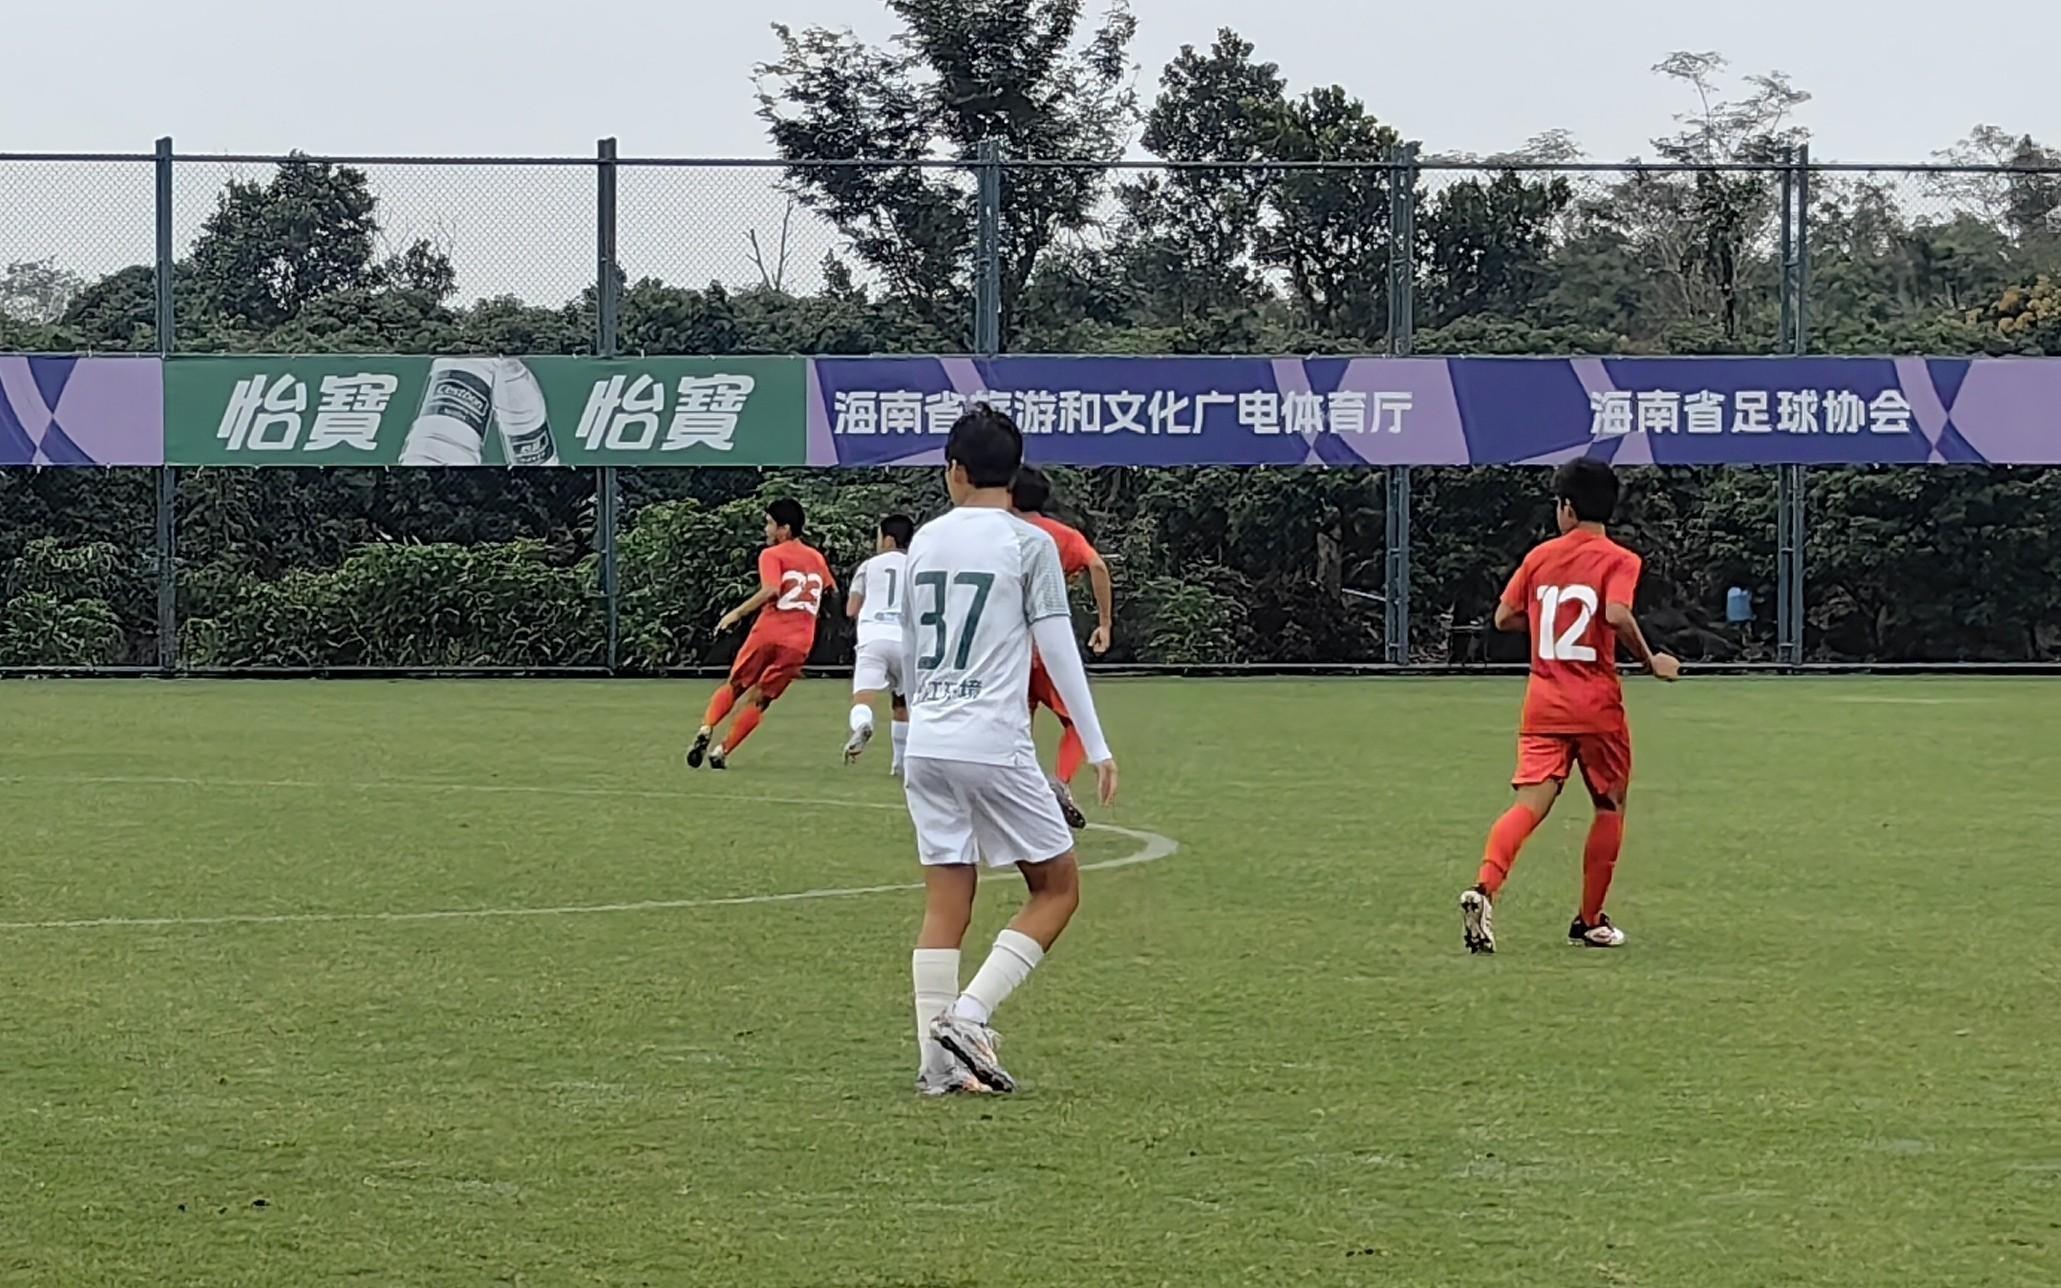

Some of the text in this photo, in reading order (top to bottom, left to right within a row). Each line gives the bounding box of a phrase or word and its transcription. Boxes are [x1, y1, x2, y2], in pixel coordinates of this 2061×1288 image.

[217, 374, 398, 451] 怡寶
[576, 374, 756, 451] 怡寶
[1590, 389, 1912, 434] 海南省足球协会
[777, 570, 823, 616] 23
[915, 571, 995, 669] 37
[1537, 584, 1598, 661] 12
